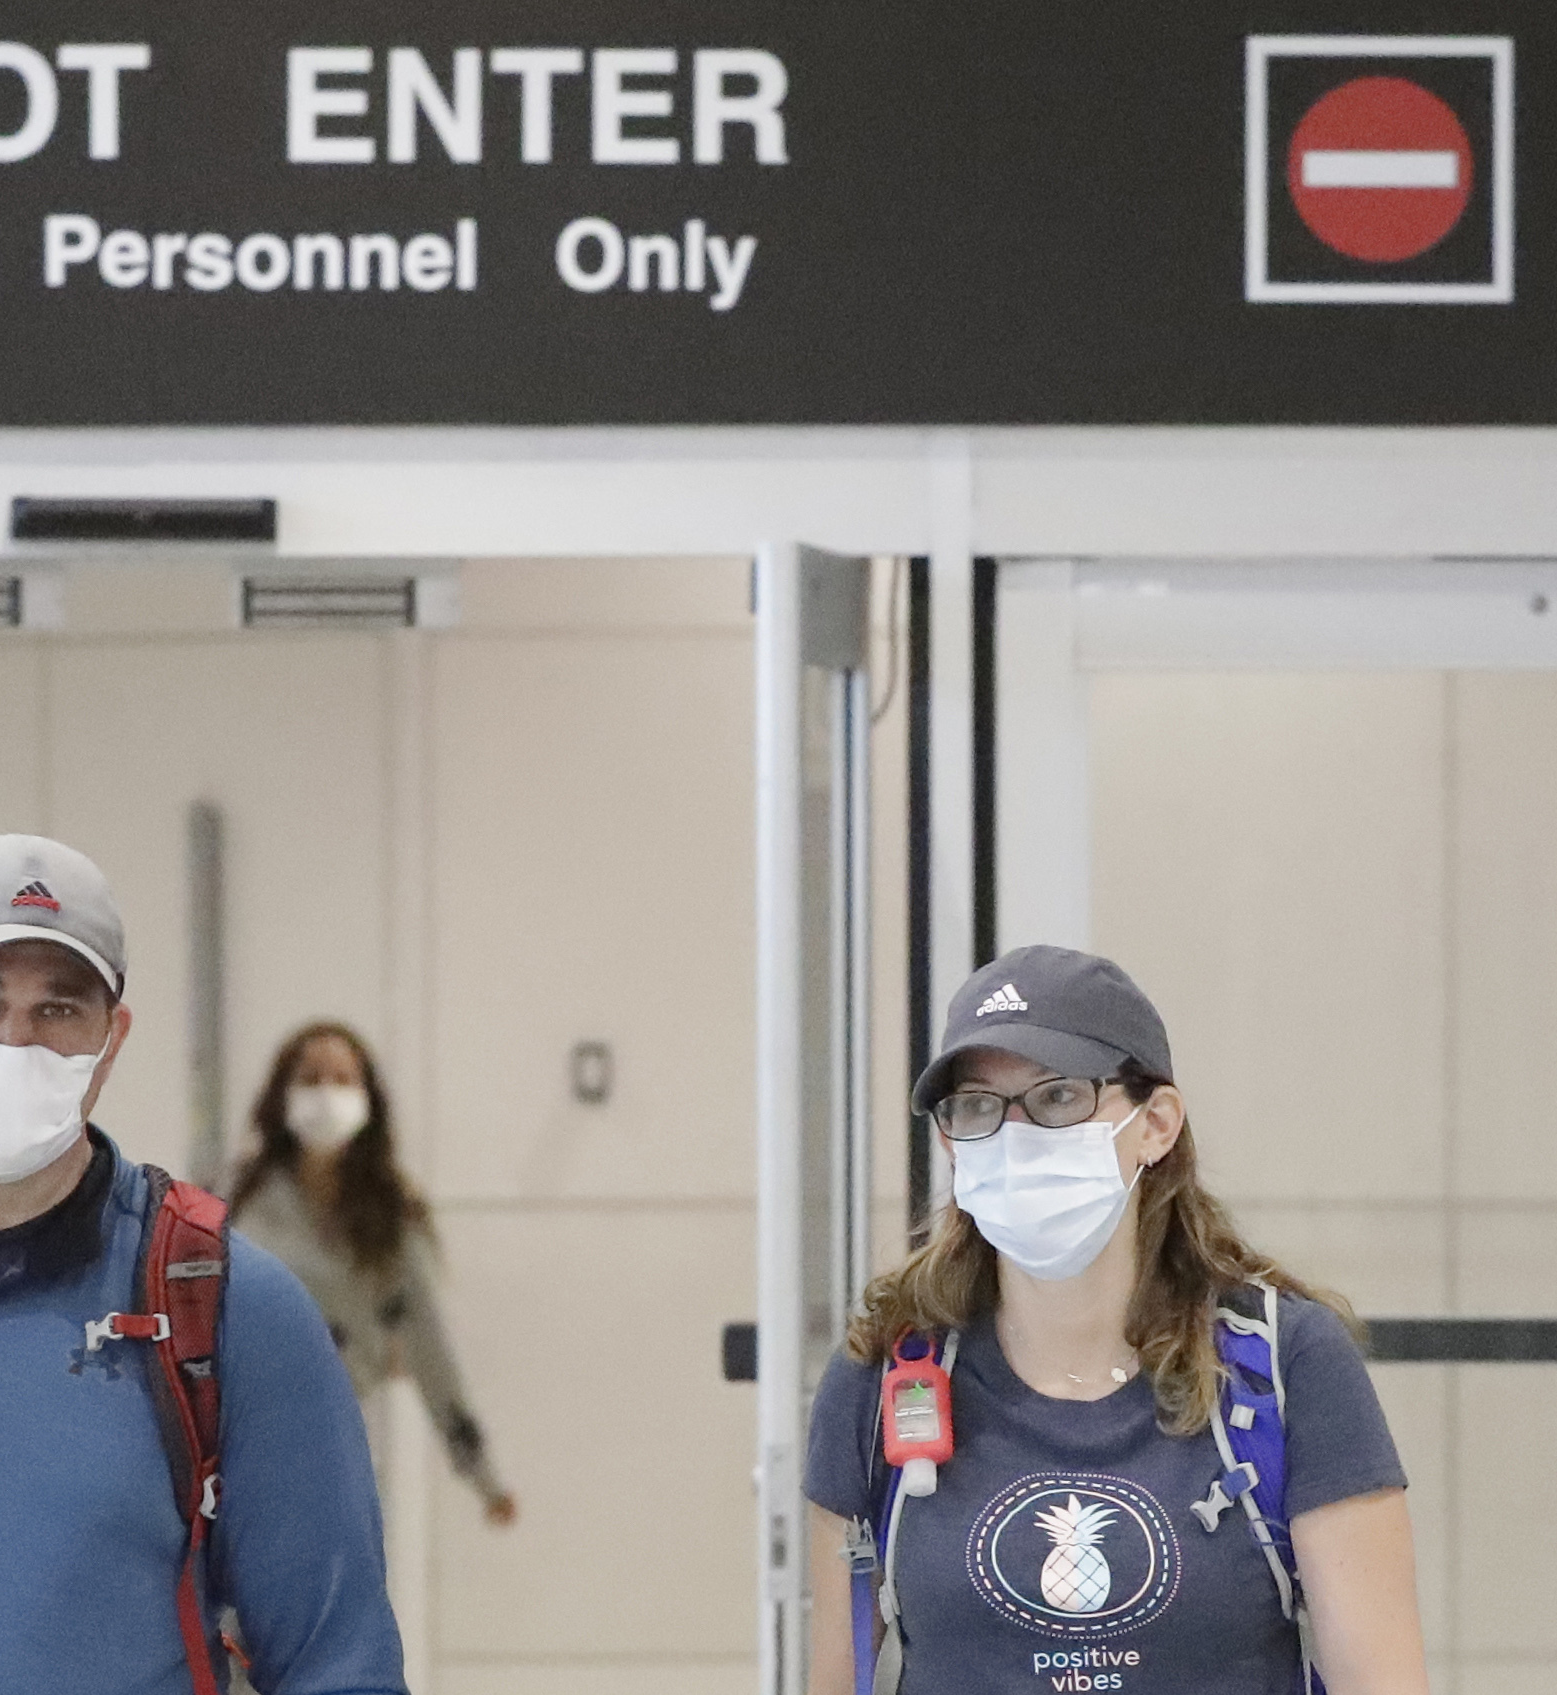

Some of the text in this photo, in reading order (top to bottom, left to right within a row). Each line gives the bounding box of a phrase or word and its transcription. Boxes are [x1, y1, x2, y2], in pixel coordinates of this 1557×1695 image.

[286, 46, 788, 166] ENTER
[43, 213, 478, 292] Personnel
[555, 216, 756, 311] Only
[976, 999, 1028, 1017] adidas
[1033, 1645, 1141, 1675] positive
[1051, 1667, 1123, 1692] vibes
